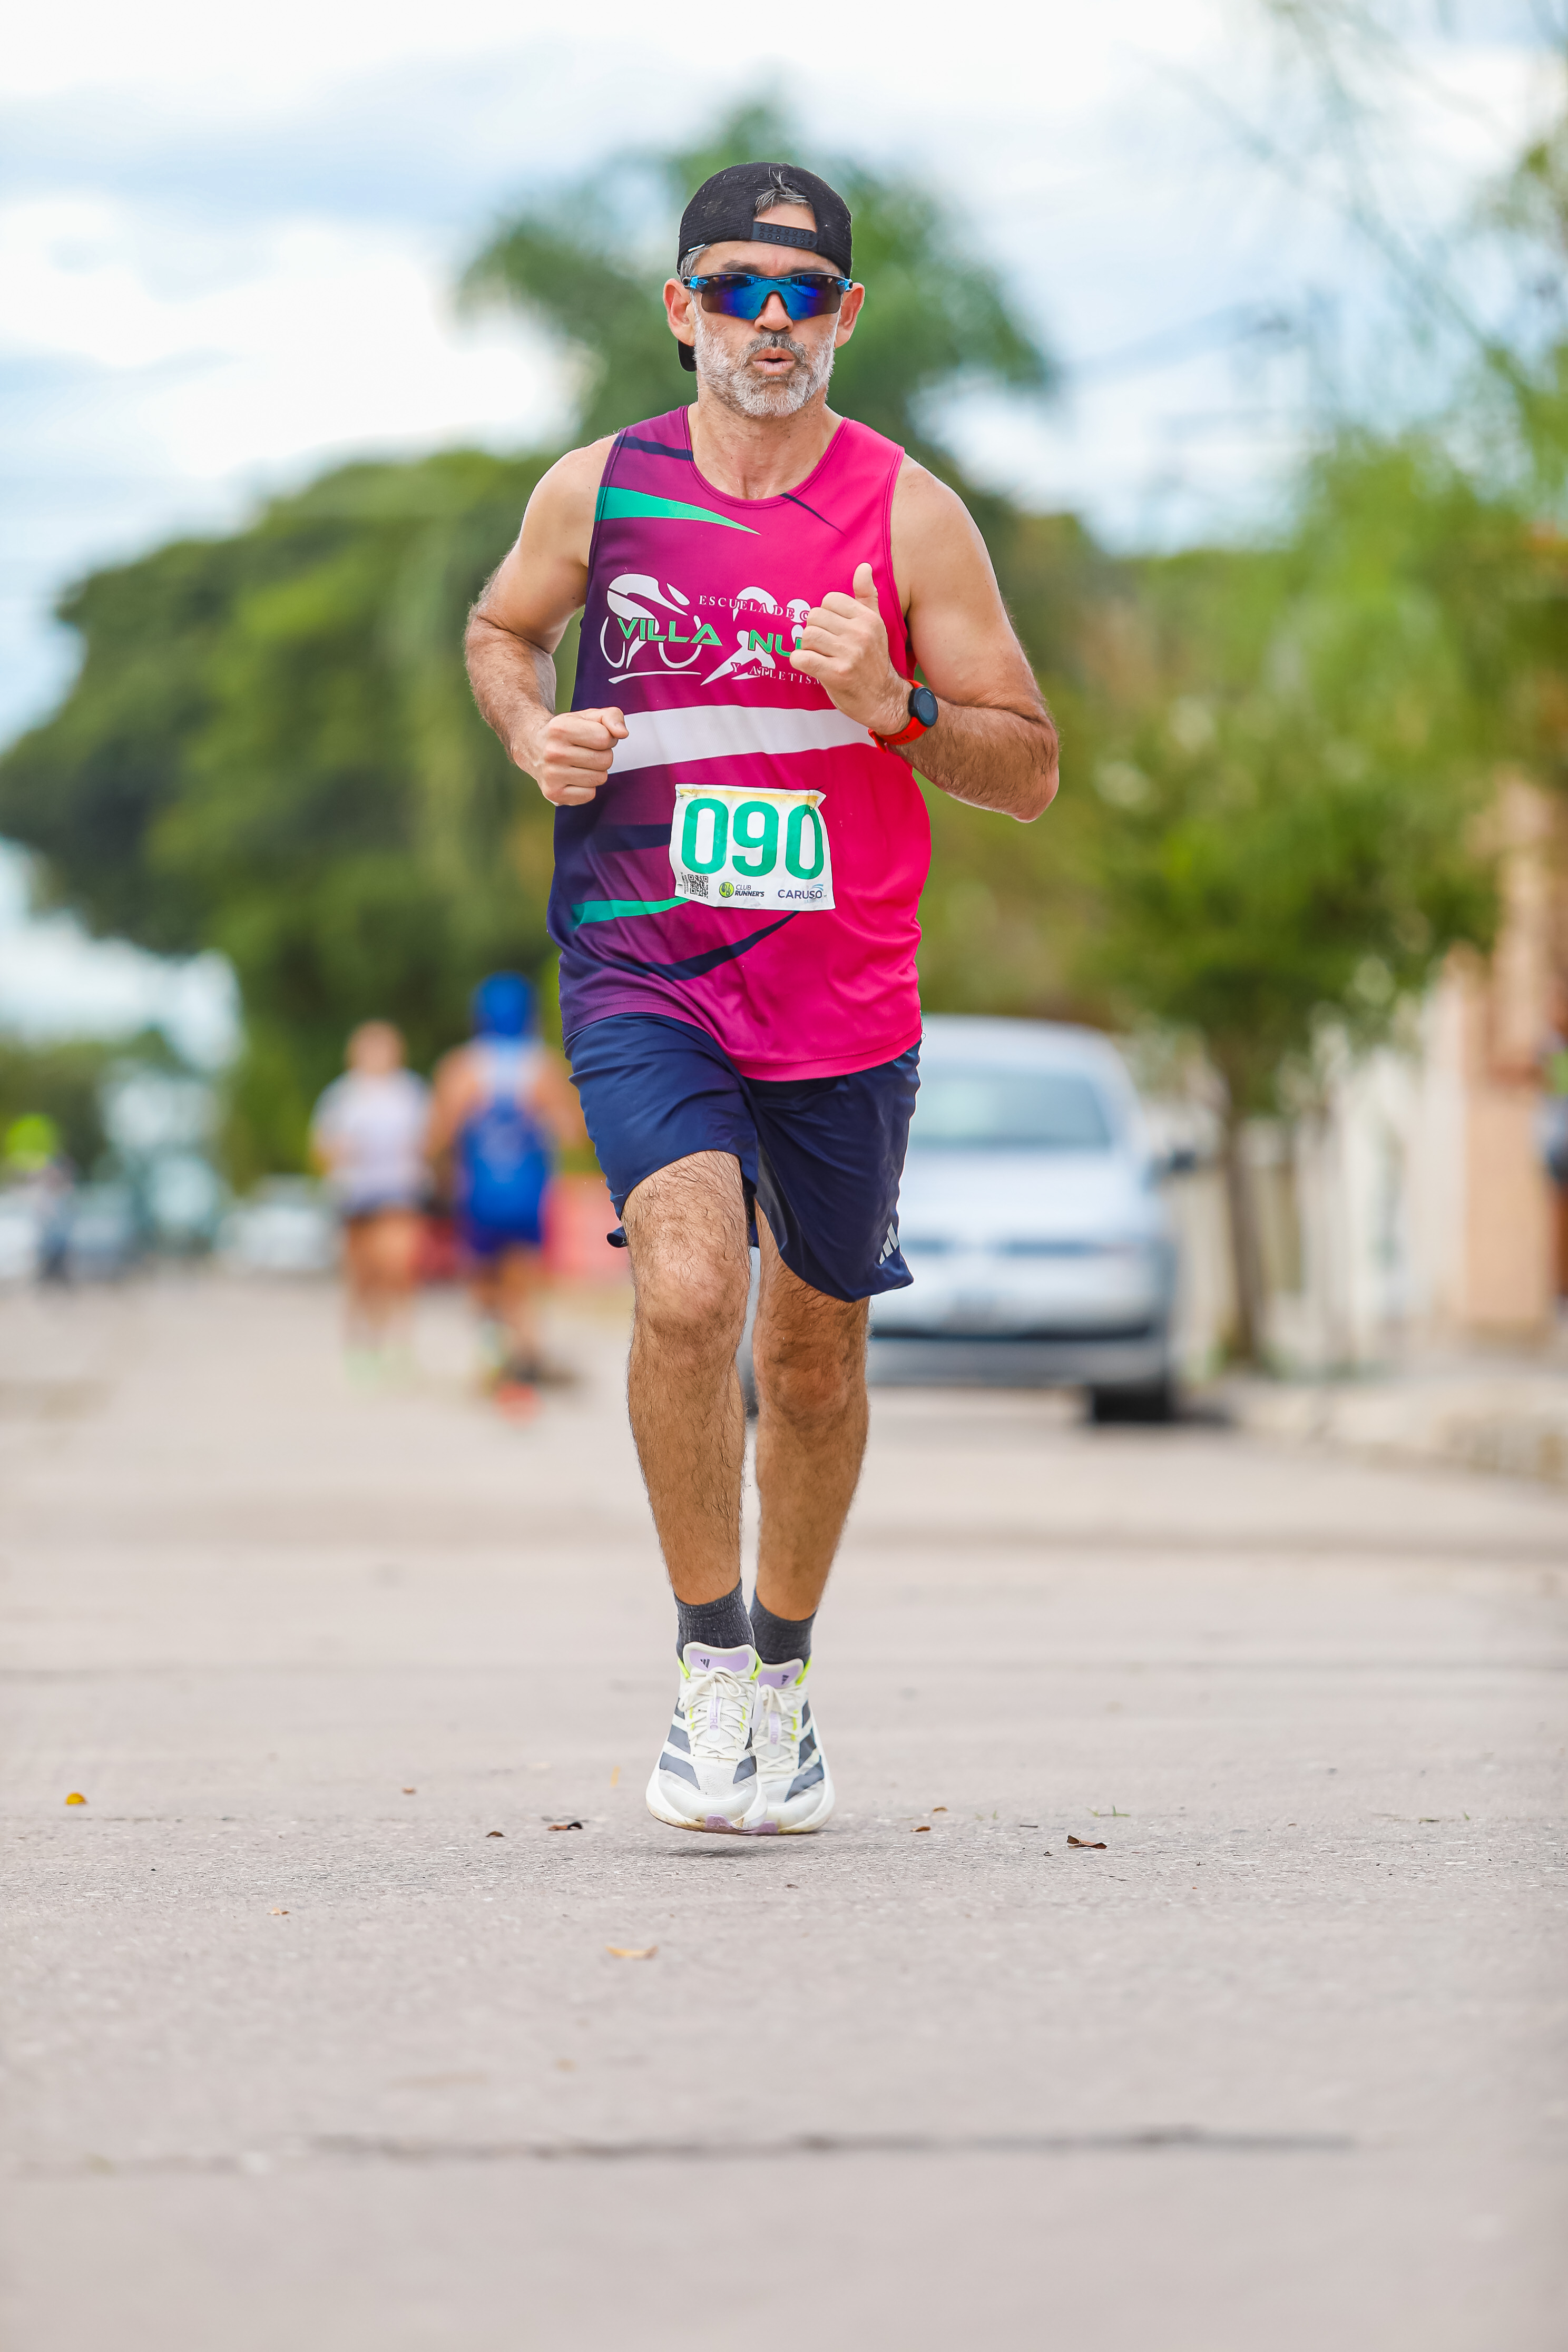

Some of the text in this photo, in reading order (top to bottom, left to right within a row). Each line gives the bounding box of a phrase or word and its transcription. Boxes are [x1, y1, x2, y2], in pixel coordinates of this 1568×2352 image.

[699, 595, 768, 613] ESCUELA
[773, 605, 795, 620] DE
[616, 617, 723, 646] VILLA
[730, 662, 741, 673] Y
[681, 798, 825, 880] 090
[778, 889, 822, 899] CARUSO
